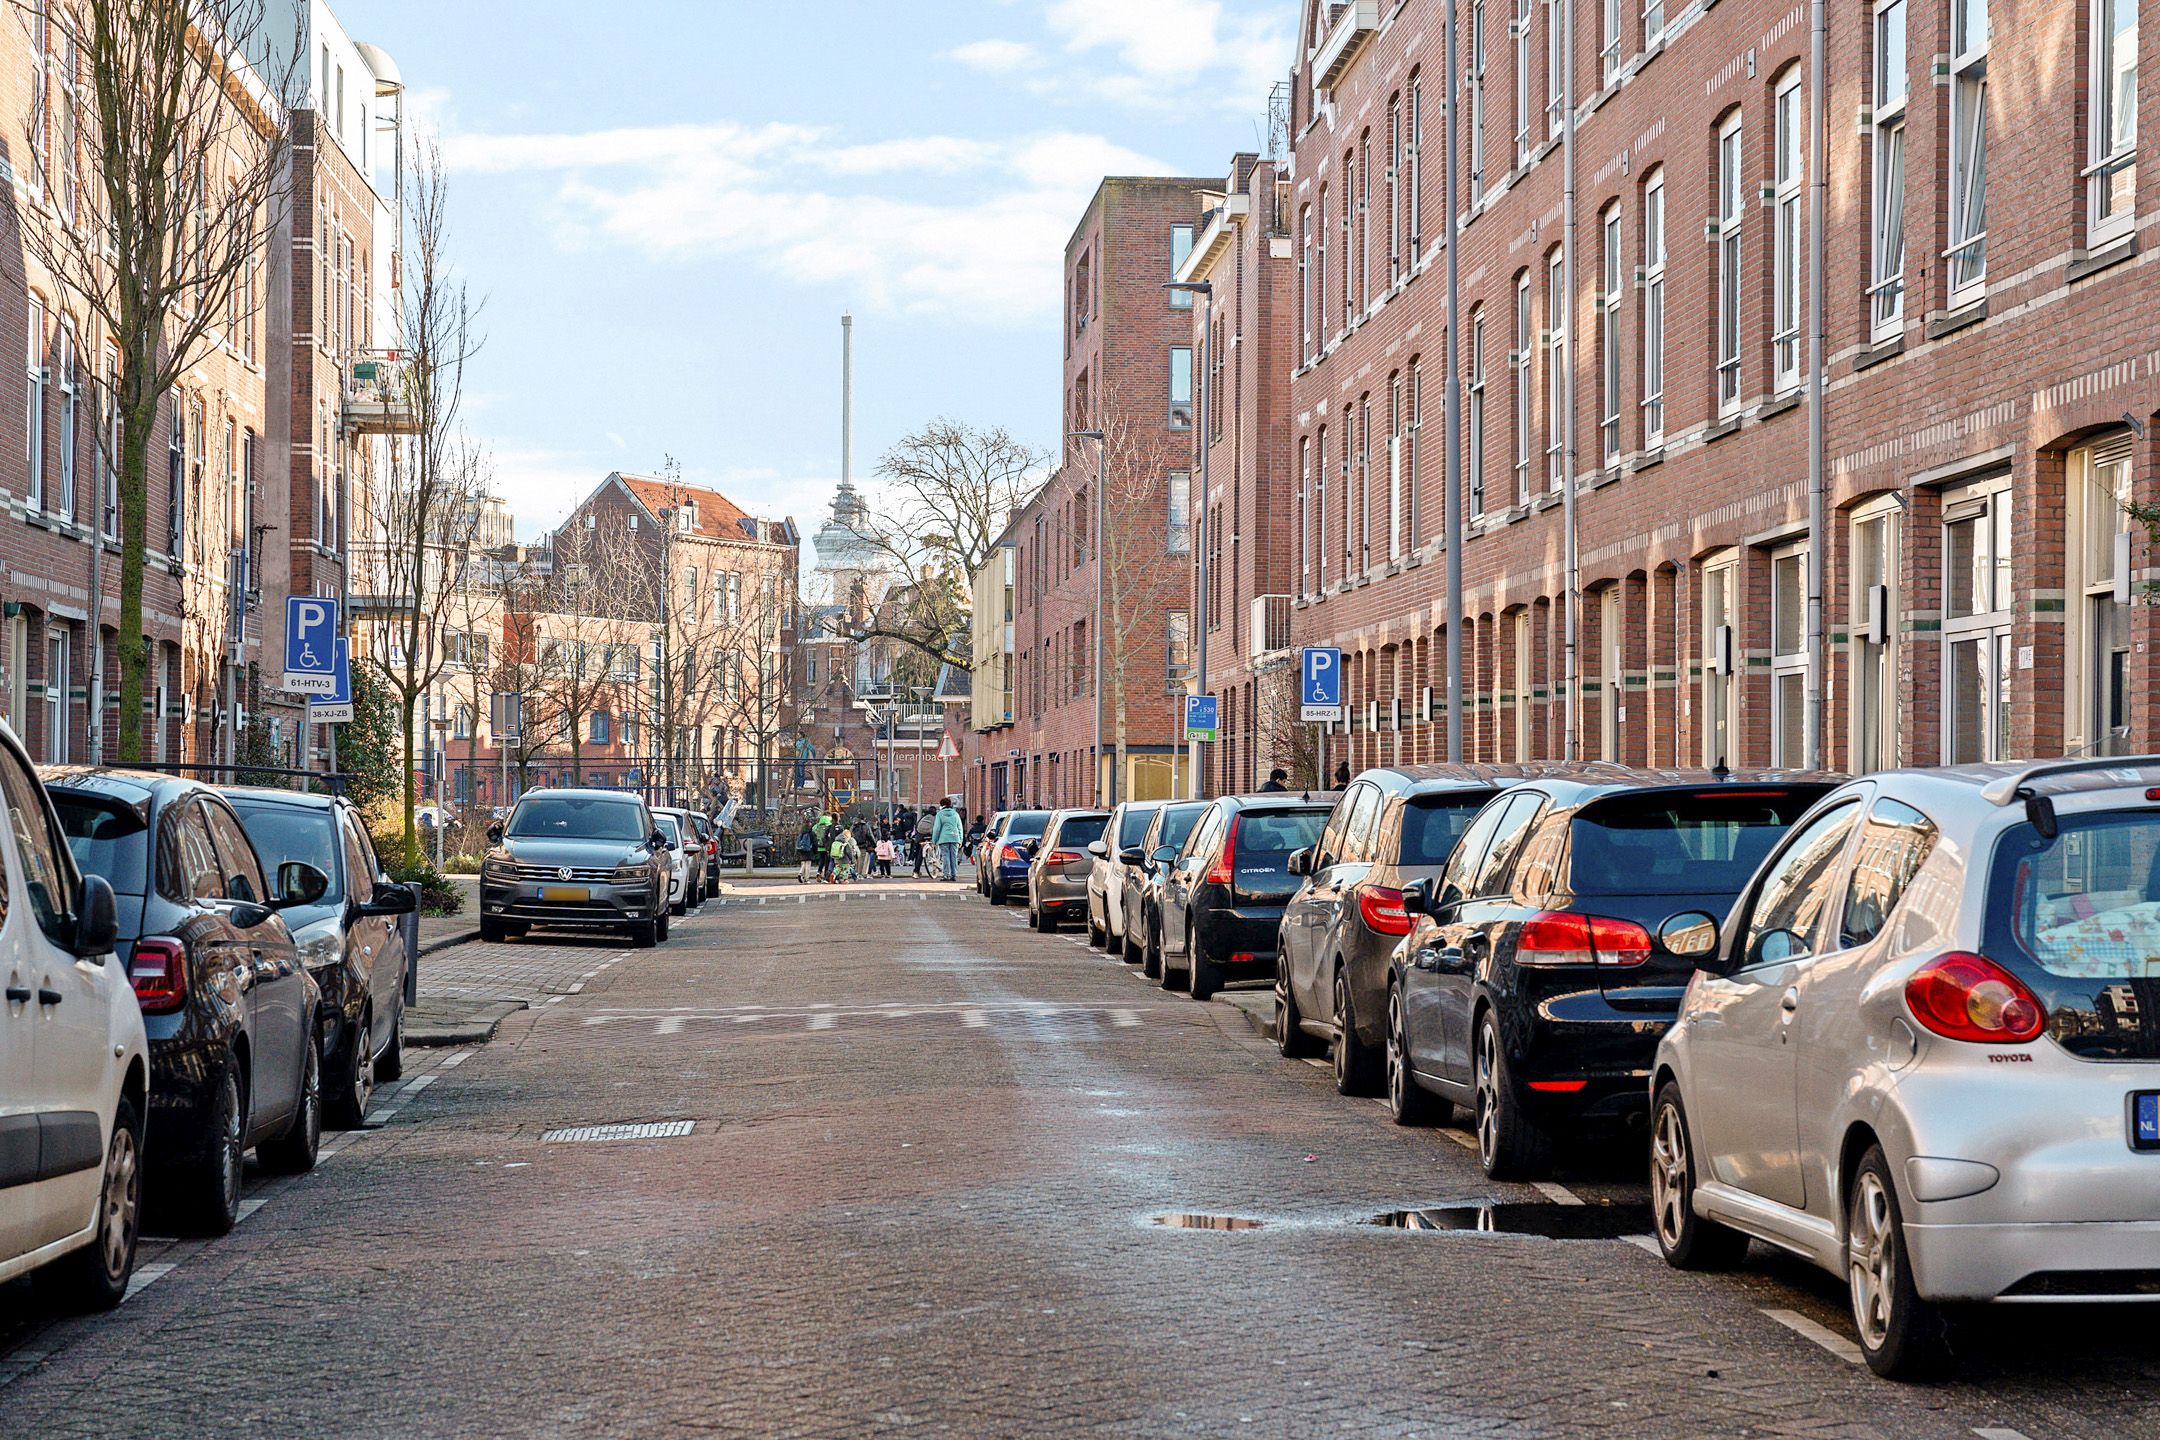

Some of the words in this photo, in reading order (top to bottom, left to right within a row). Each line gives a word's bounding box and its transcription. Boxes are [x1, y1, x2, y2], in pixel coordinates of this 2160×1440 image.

[298, 603, 325, 640] P
[1311, 651, 1332, 681] P
[291, 679, 330, 689] 61-HTV-3
[1189, 697, 1200, 712] P
[312, 709, 348, 718] 38-XJ-ZB
[1988, 1053, 2033, 1062] TOYOTA
[2140, 1120, 2156, 1131] NL
